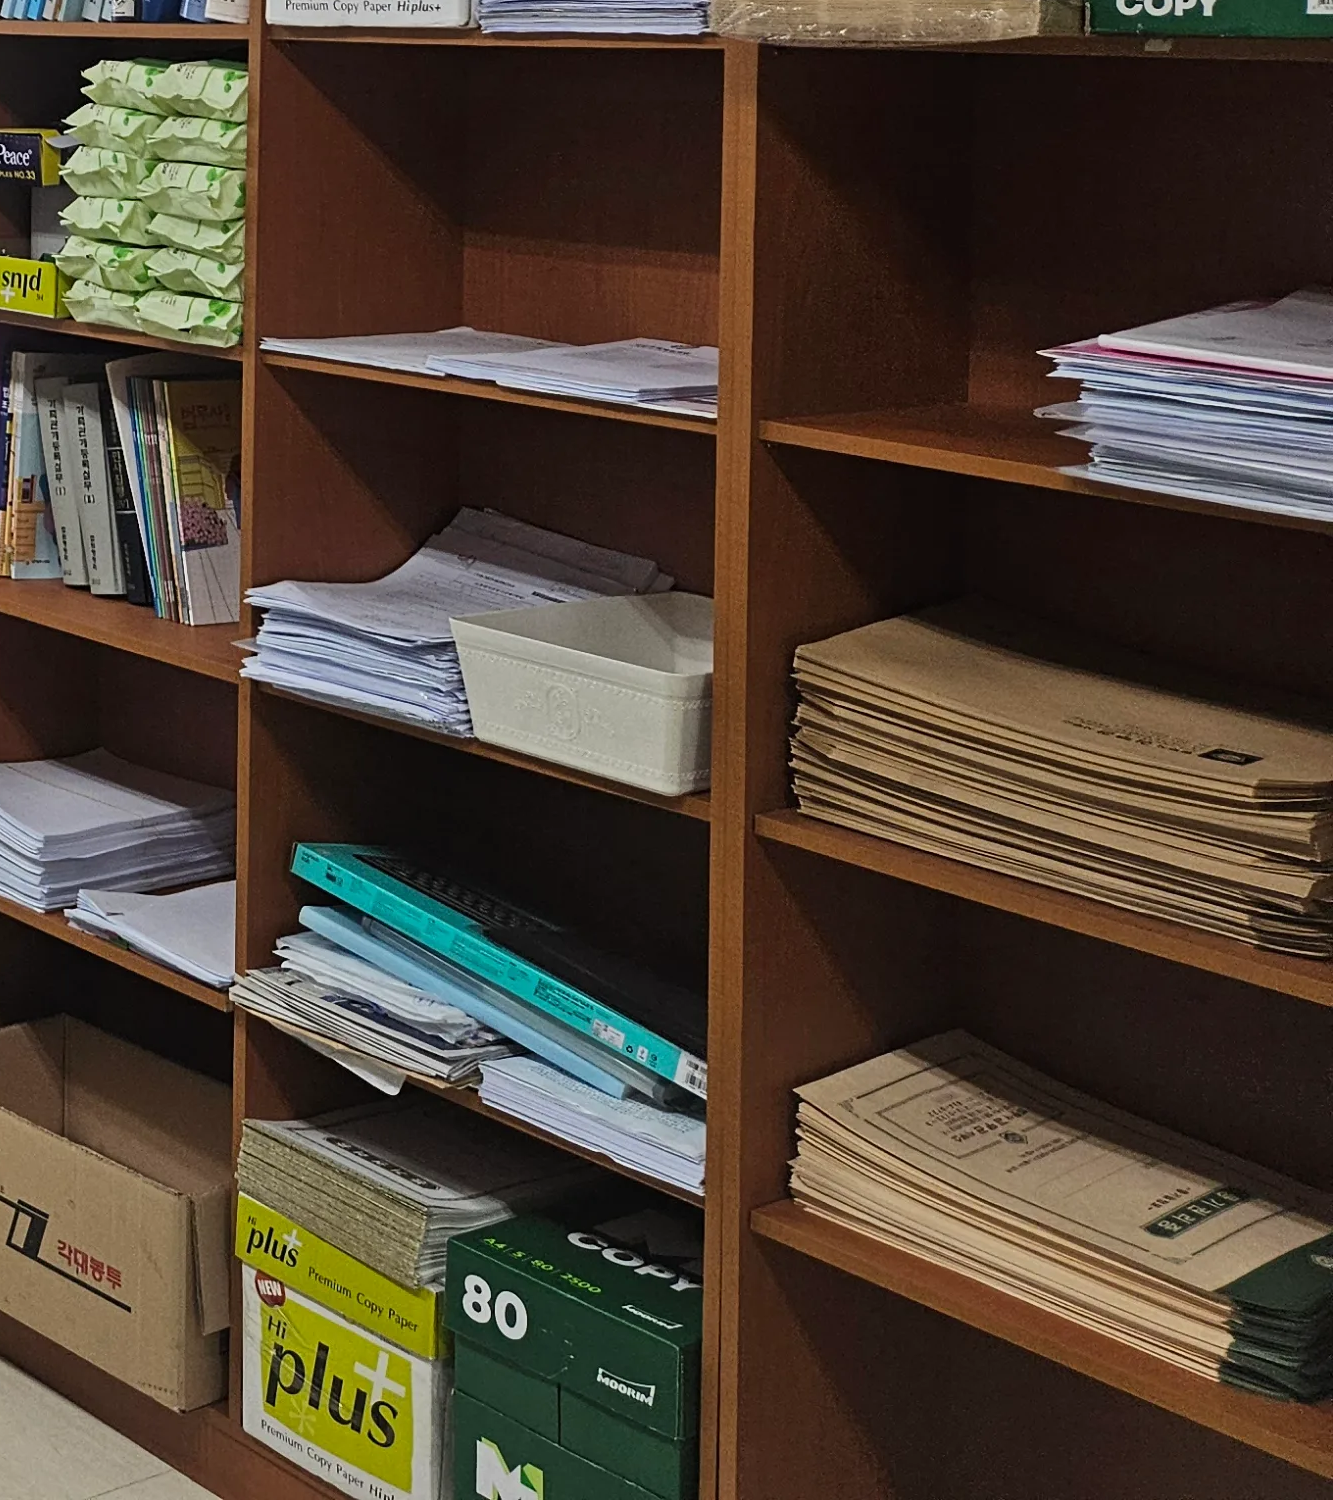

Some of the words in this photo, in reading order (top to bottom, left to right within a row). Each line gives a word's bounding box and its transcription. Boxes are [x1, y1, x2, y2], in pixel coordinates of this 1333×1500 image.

[285, 0, 329, 13] Premium
[333, 0, 359, 16] Copy
[363, 0, 391, 16] Paper
[1, 268, 43, 299] plus
[247, 1215, 257, 1226] Hi
[57, 1239, 122, 1290] 각대봉투
[246, 1224, 299, 1268] plus
[483, 1237, 507, 1250] A4
[530, 1259, 554, 1272] 80
[559, 1273, 602, 1294] 2500
[567, 1232, 702, 1292] COPY
[257, 1278, 282, 1297] NEW
[308, 1266, 353, 1299] Premium
[356, 1292, 384, 1318] Copy
[388, 1307, 419, 1333] Paper
[462, 1274, 528, 1340] 80
[268, 1315, 287, 1339] Hi
[264, 1341, 399, 1448] plus
[596, 1367, 656, 1407] MOORIM
[260, 1419, 303, 1452] Premium
[307, 1445, 332, 1472] Copy
[336, 1463, 365, 1489] Paper
